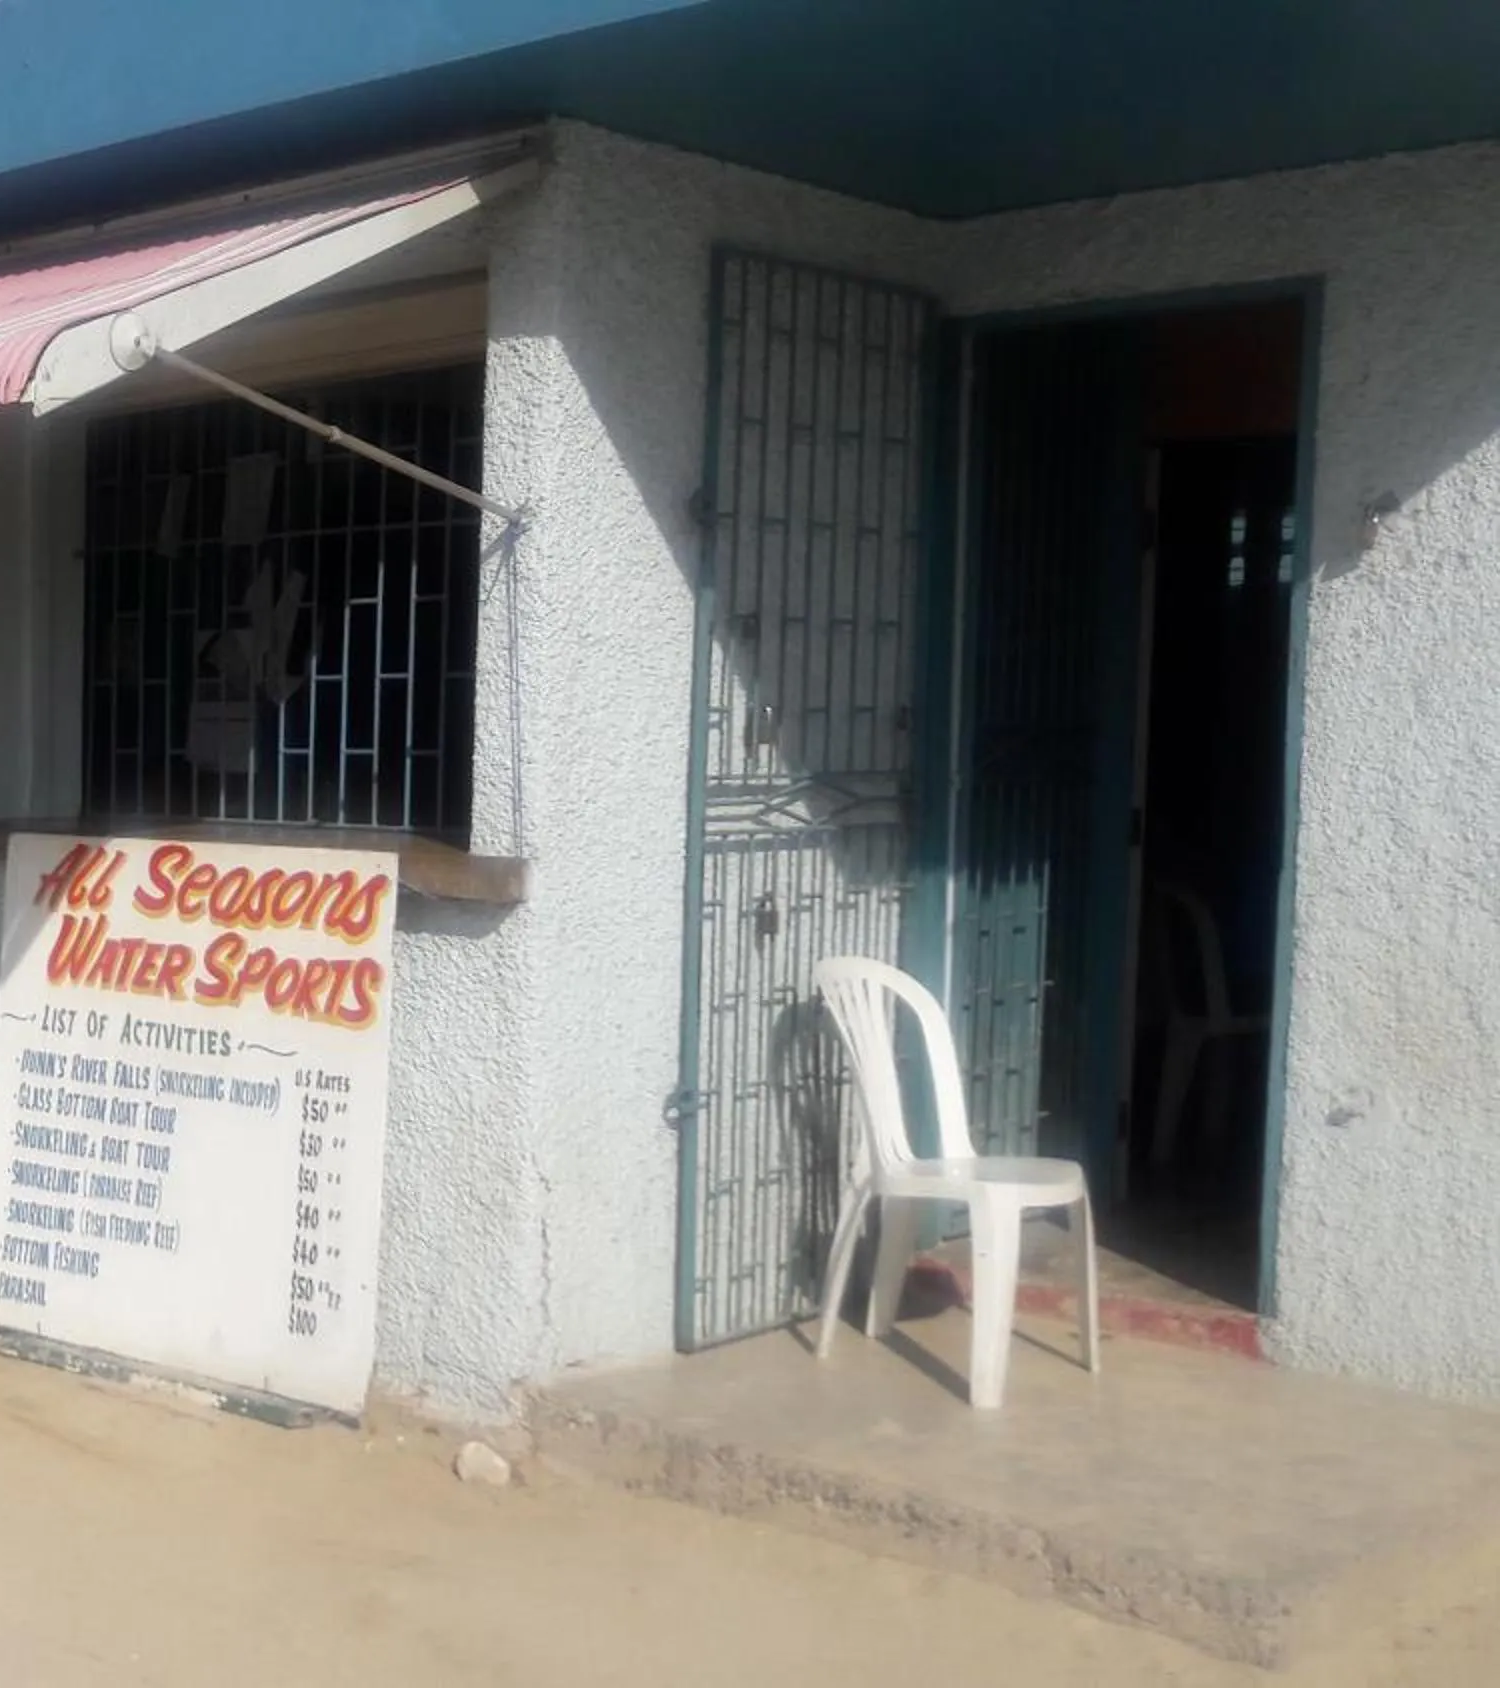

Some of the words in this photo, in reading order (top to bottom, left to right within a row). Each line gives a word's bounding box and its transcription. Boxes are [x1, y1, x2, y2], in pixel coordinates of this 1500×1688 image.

[132, 843, 390, 944] Seasons
[42, 1005, 77, 1033] LIST
[87, 1010, 109, 1040] OF
[119, 1012, 232, 1057] ACTIVITIES
[71, 1053, 108, 1086] RIVER
[113, 1060, 151, 1090] FALLS
[18, 1082, 53, 1113] GLASS
[56, 1087, 107, 1124] BOTTOM
[109, 1096, 140, 1128] BOAT
[145, 1101, 177, 1134] TOUR
[14, 1119, 89, 1158] SNORKELING
[100, 1135, 129, 1166] BOAT
[136, 1141, 171, 1171] TOUR
[11, 1159, 81, 1195] SNORKELING
[7, 1198, 75, 1233] SNORKELING
[2, 1233, 50, 1270] BOTTOM
[53, 1240, 100, 1279] FISHING
